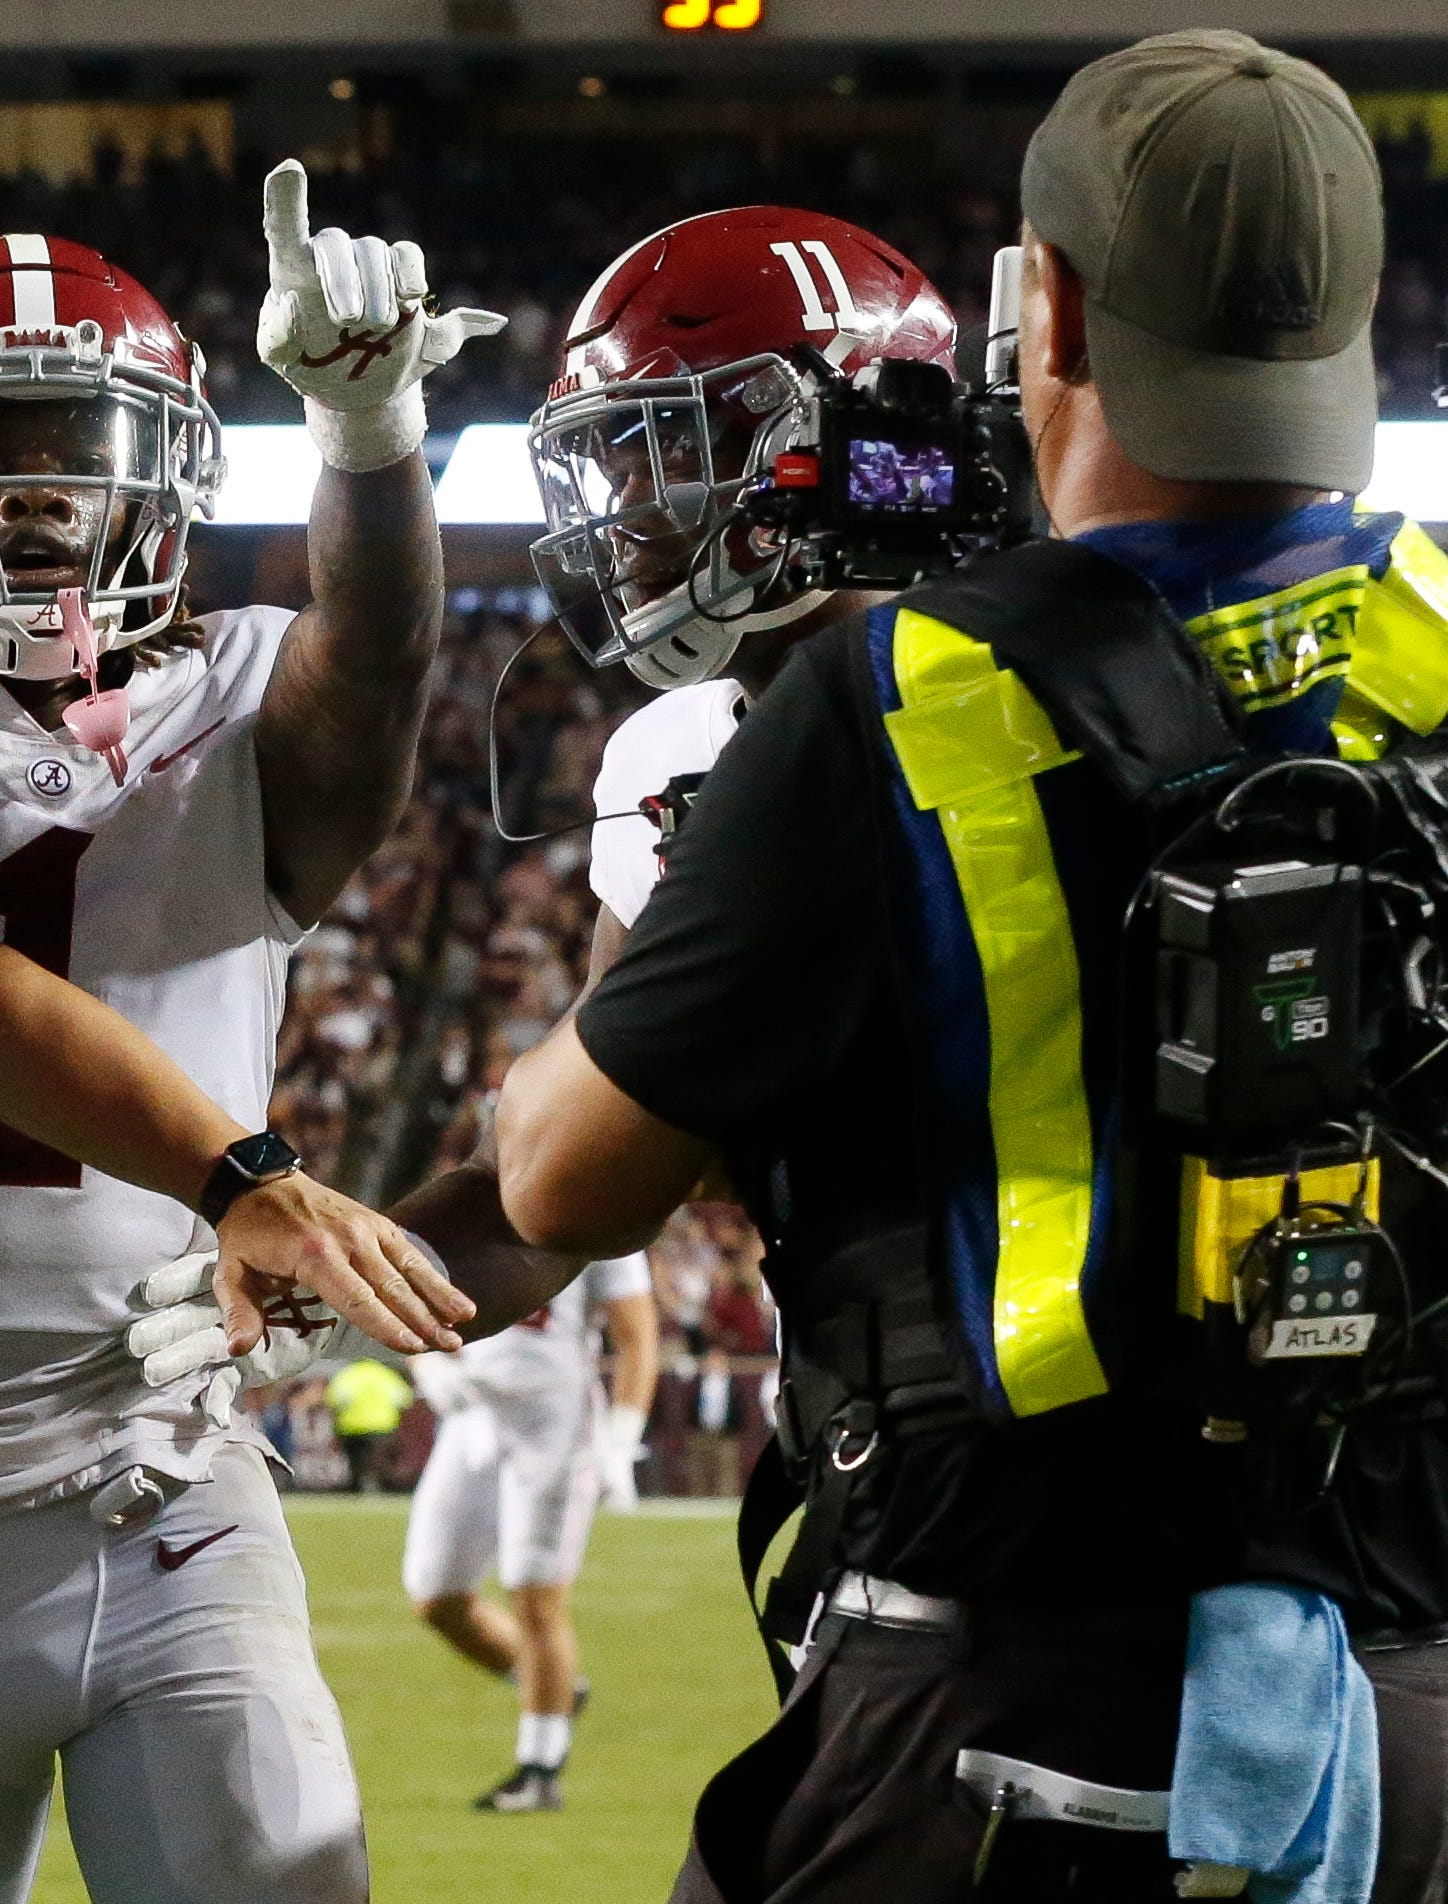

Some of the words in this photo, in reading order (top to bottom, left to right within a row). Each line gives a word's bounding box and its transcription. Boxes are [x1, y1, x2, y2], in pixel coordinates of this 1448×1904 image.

[769, 240, 864, 330] 11
[4, 329, 68, 348] BAMA
[1223, 605, 1359, 679] SPORT
[1286, 1322, 1359, 1347] ATLAS
